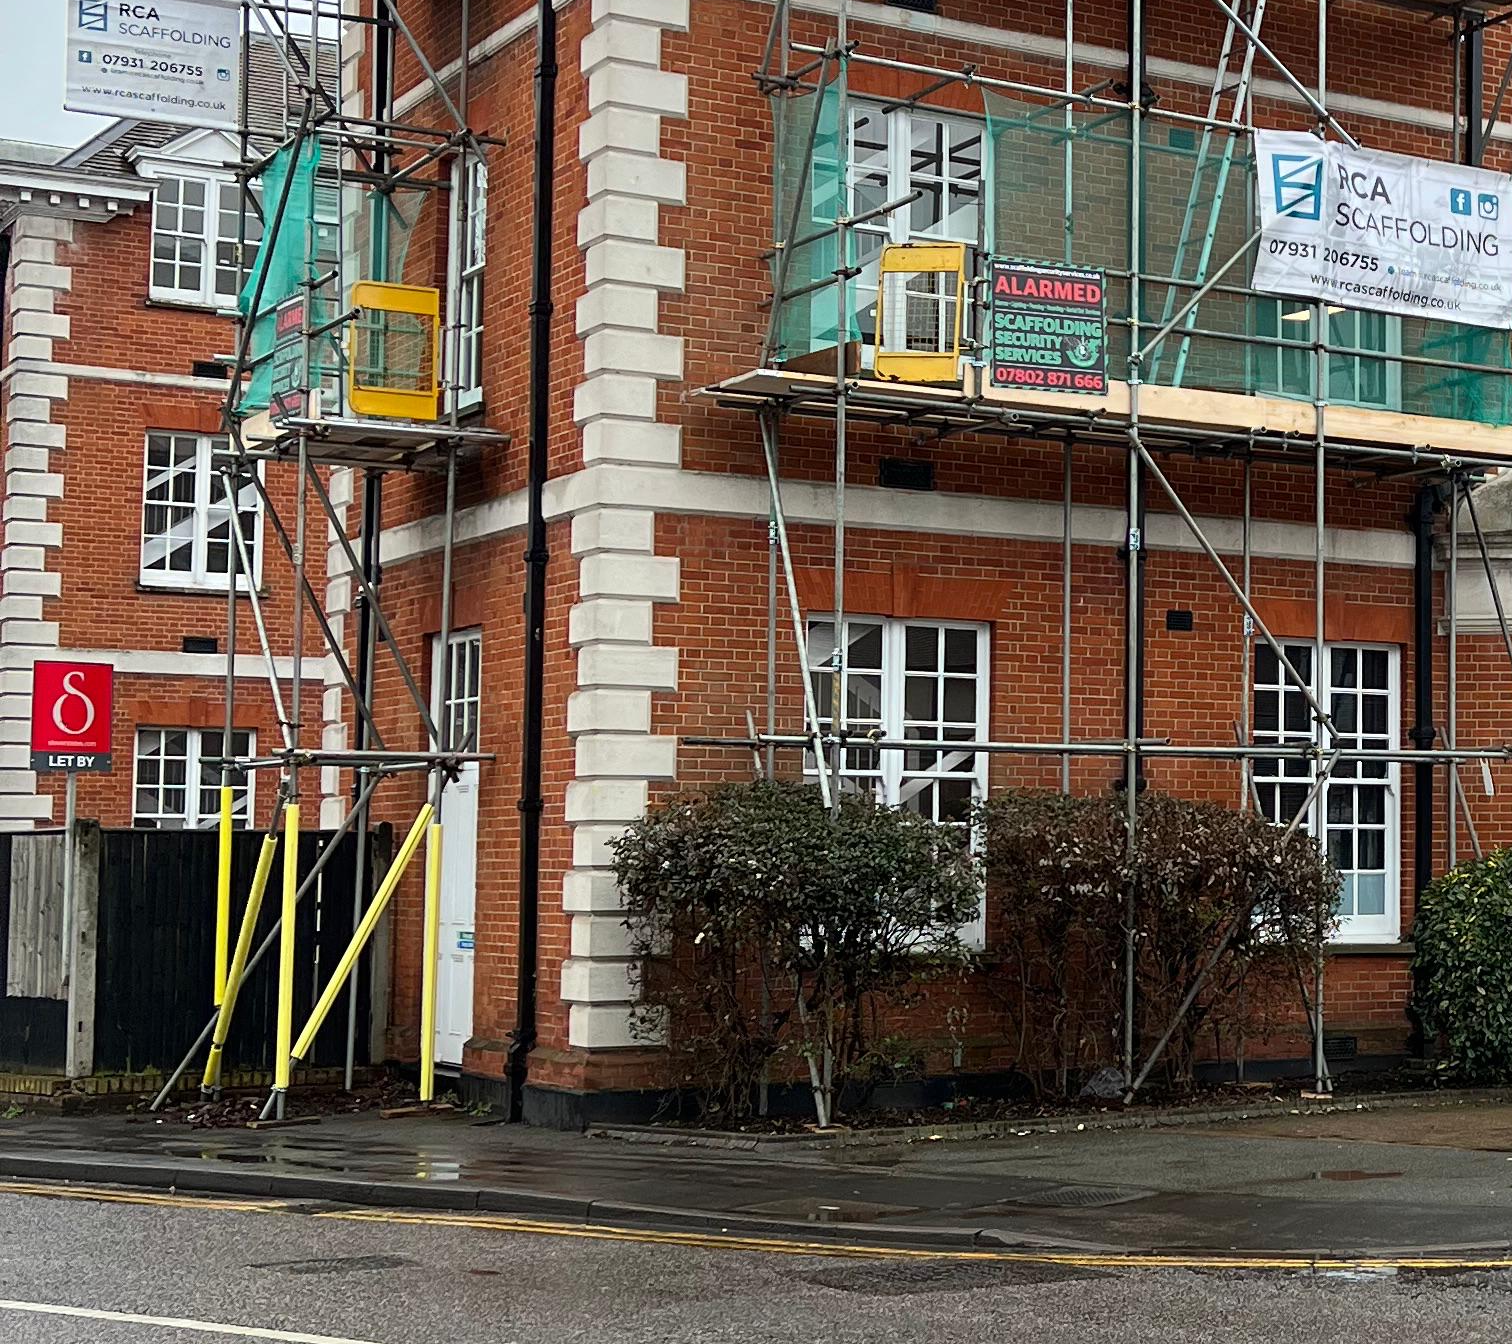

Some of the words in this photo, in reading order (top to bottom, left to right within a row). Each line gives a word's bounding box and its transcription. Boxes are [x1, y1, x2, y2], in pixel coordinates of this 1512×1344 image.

[119, 3, 160, 21] RCA
[119, 22, 231, 49] SCAFFOLDING
[102, 54, 144, 69] 07931
[150, 60, 204, 77] 206755
[81, 85, 226, 111] www.rcascaffolding.co.uk
[1336, 163, 1391, 205] RCA
[1334, 202, 1499, 257] SCAFFOLDING
[1269, 239, 1317, 259] 07931
[1323, 247, 1380, 272] 206755
[995, 275, 1101, 304] ALARMED
[1310, 273, 1462, 312] www.rcascaffolding.co.uk
[994, 313, 1103, 338] SCAFFOLDING
[995, 330, 1063, 350] SECURITY
[995, 346, 1062, 365] SERVICES
[996, 367, 1044, 384] 07802
[1047, 371, 1072, 387] 871
[1074, 374, 1103, 389] 666
[48, 755, 75, 767] LET
[76, 755, 95, 768] BY
